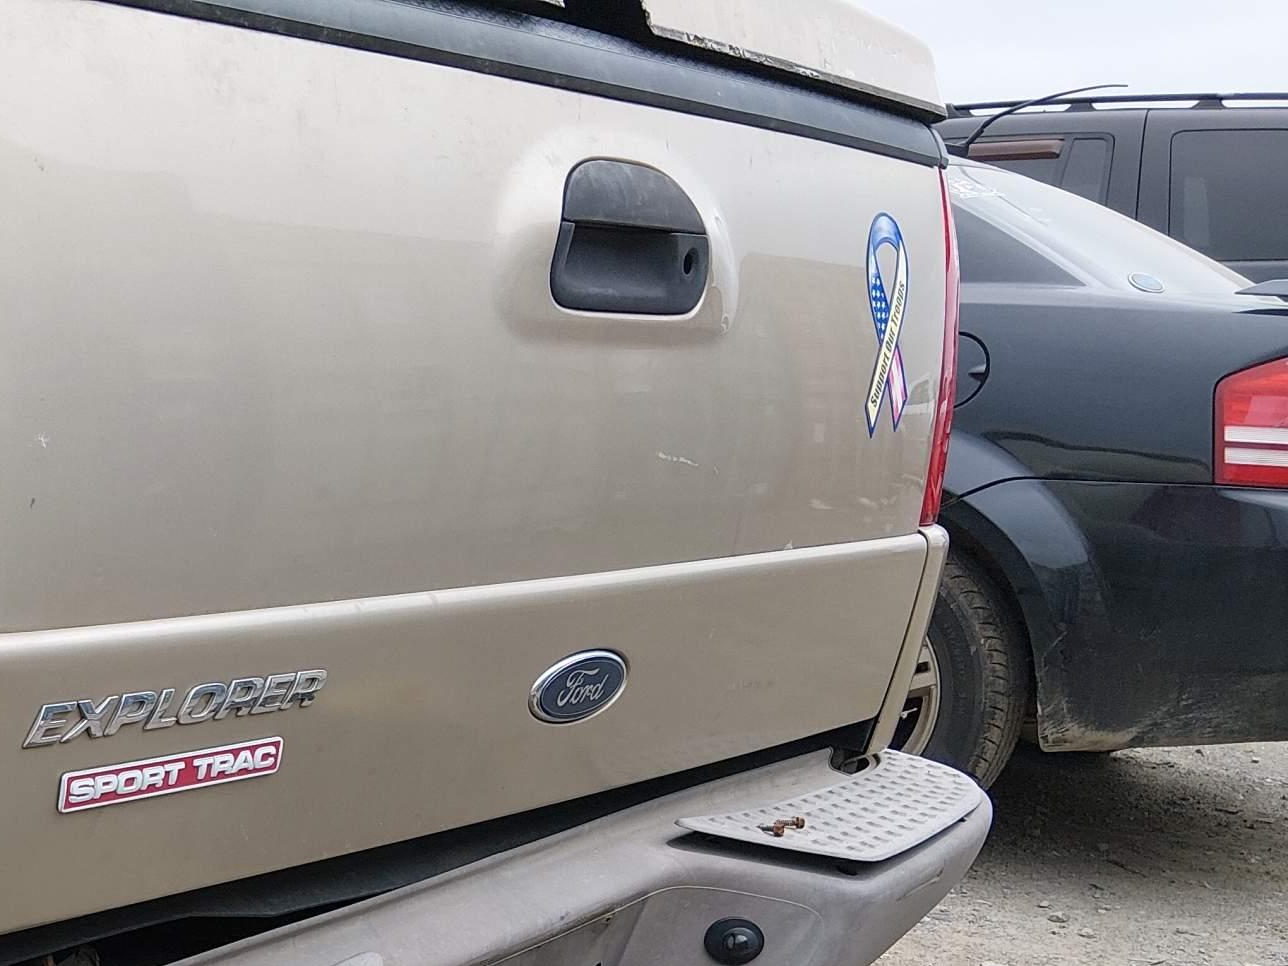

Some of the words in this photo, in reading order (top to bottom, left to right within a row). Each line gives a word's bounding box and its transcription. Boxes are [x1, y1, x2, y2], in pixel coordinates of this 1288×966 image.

[870, 354, 890, 408] Support
[885, 325, 897, 353] Our
[891, 280, 906, 327] Troops
[21, 669, 328, 749] EXPLORER
[556, 667, 609, 707] Ford
[68, 761, 186, 803] SPORT
[193, 745, 277, 780] TRAC
